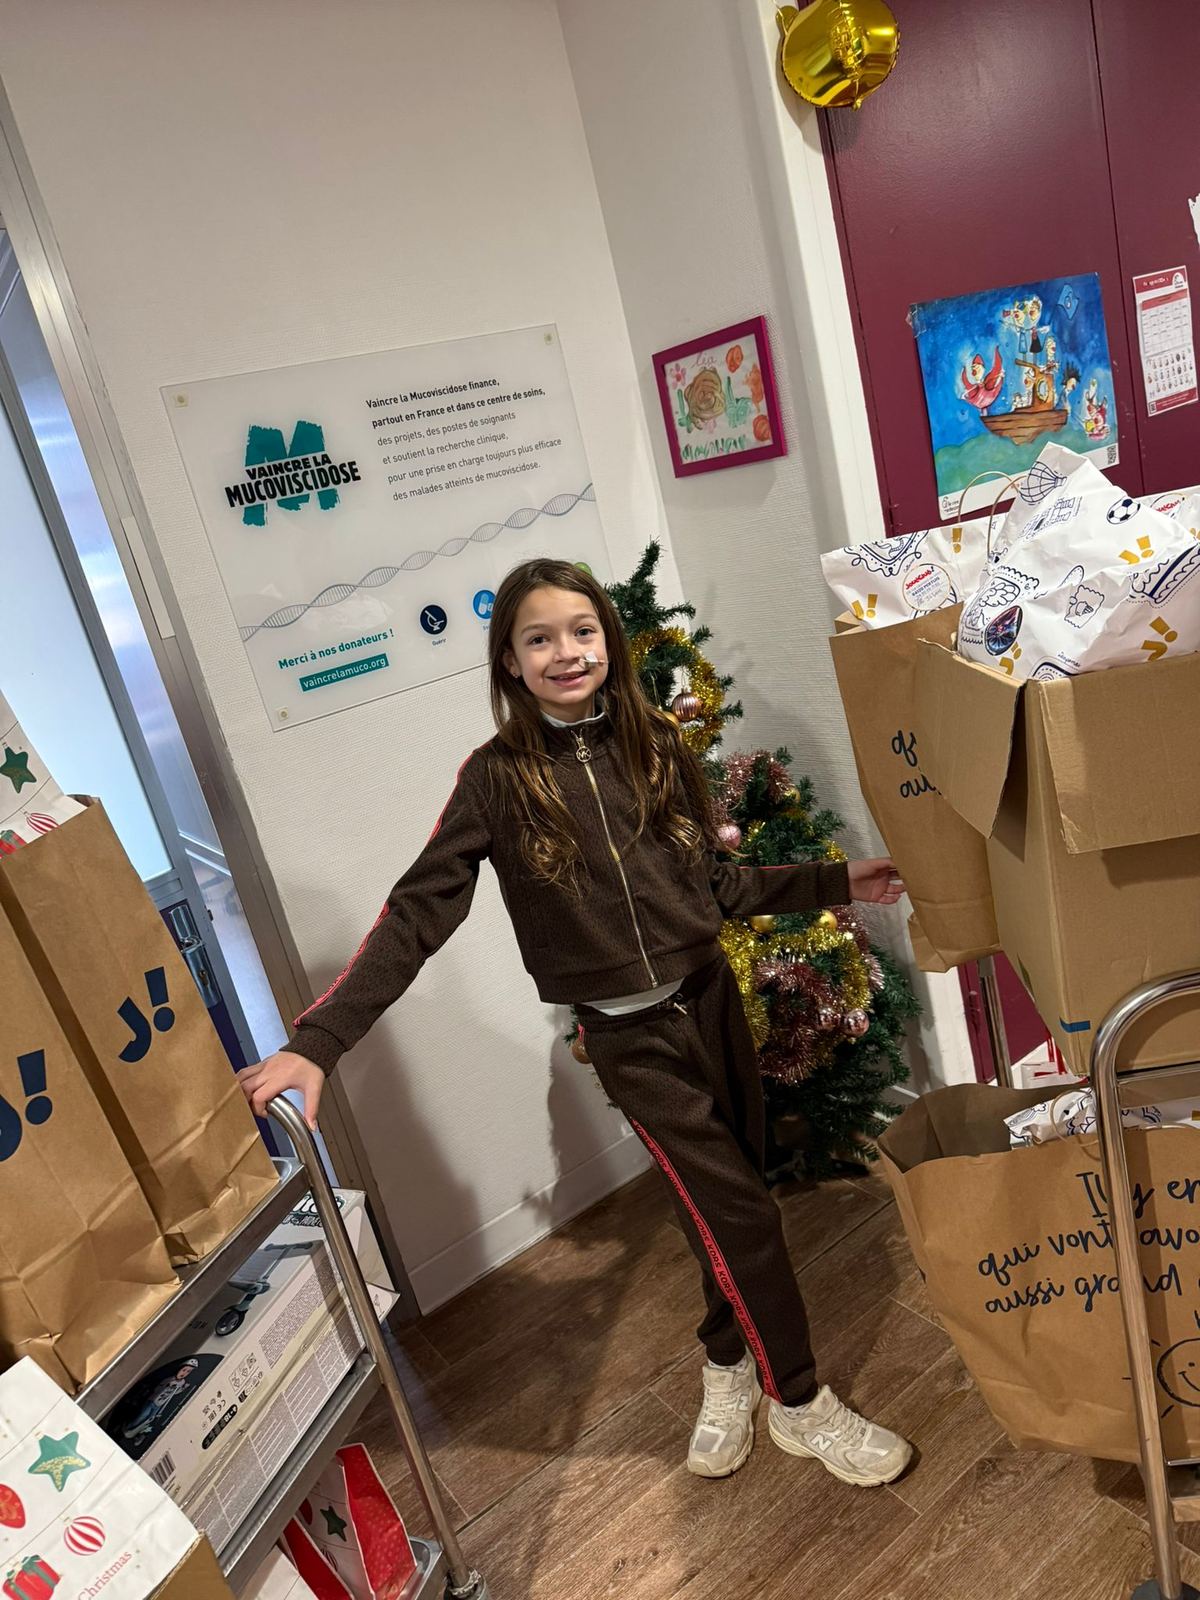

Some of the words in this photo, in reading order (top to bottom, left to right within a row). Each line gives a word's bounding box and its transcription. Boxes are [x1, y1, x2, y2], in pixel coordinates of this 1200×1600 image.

[366, 397, 398, 408] Vaincre
[399, 394, 408, 402] la
[409, 385, 468, 401] Mucoviscidose
[469, 379, 499, 390] finance,
[372, 414, 404, 429] partout
[417, 408, 445, 419] France
[447, 404, 455, 413] et
[456, 402, 475, 411] dans
[487, 395, 511, 405] centre
[513, 392, 522, 400] de
[523, 388, 545, 398] soins,
[378, 437, 392, 446] des
[394, 432, 425, 445] projets,
[426, 428, 440, 436] des
[442, 422, 467, 435] postes
[469, 419, 478, 427] de
[480, 412, 516, 425] soignants
[383, 456, 391, 464] et
[393, 449, 425, 462] soutient
[426, 447, 435, 455] la
[436, 439, 475, 453] recherche
[477, 433, 508, 444] clinique,
[388, 473, 406, 485] pour
[409, 470, 424, 478] une
[426, 465, 445, 477] prise
[447, 462, 457, 470] en
[458, 456, 484, 467] charge
[486, 449, 516, 461] toujours
[518, 445, 533, 456] plus
[535, 439, 561, 450] efficace
[225, 461, 361, 508] MUCOVISCIDOSE
[246, 457, 311, 480] VAINCRE
[313, 454, 332, 467] LA
[393, 492, 408, 501] des
[409, 484, 443, 497] malades
[445, 477, 474, 489] atteints
[475, 473, 484, 482] de
[486, 462, 540, 479] mucoviscidose.
[278, 653, 308, 669] Merci
[310, 650, 317, 660] à
[318, 647, 337, 658] nos
[338, 632, 388, 652] donateurs
[303, 658, 386, 689] vaincrelamuco.org
[704, 1243, 723, 1268] KORS
[978, 1242, 1040, 1286] qui
[1047, 1219, 1114, 1256] vont
[716, 1269, 734, 1294] KORS
[985, 1277, 1065, 1313] aussi
[78, 1552, 132, 1600] Christmas
